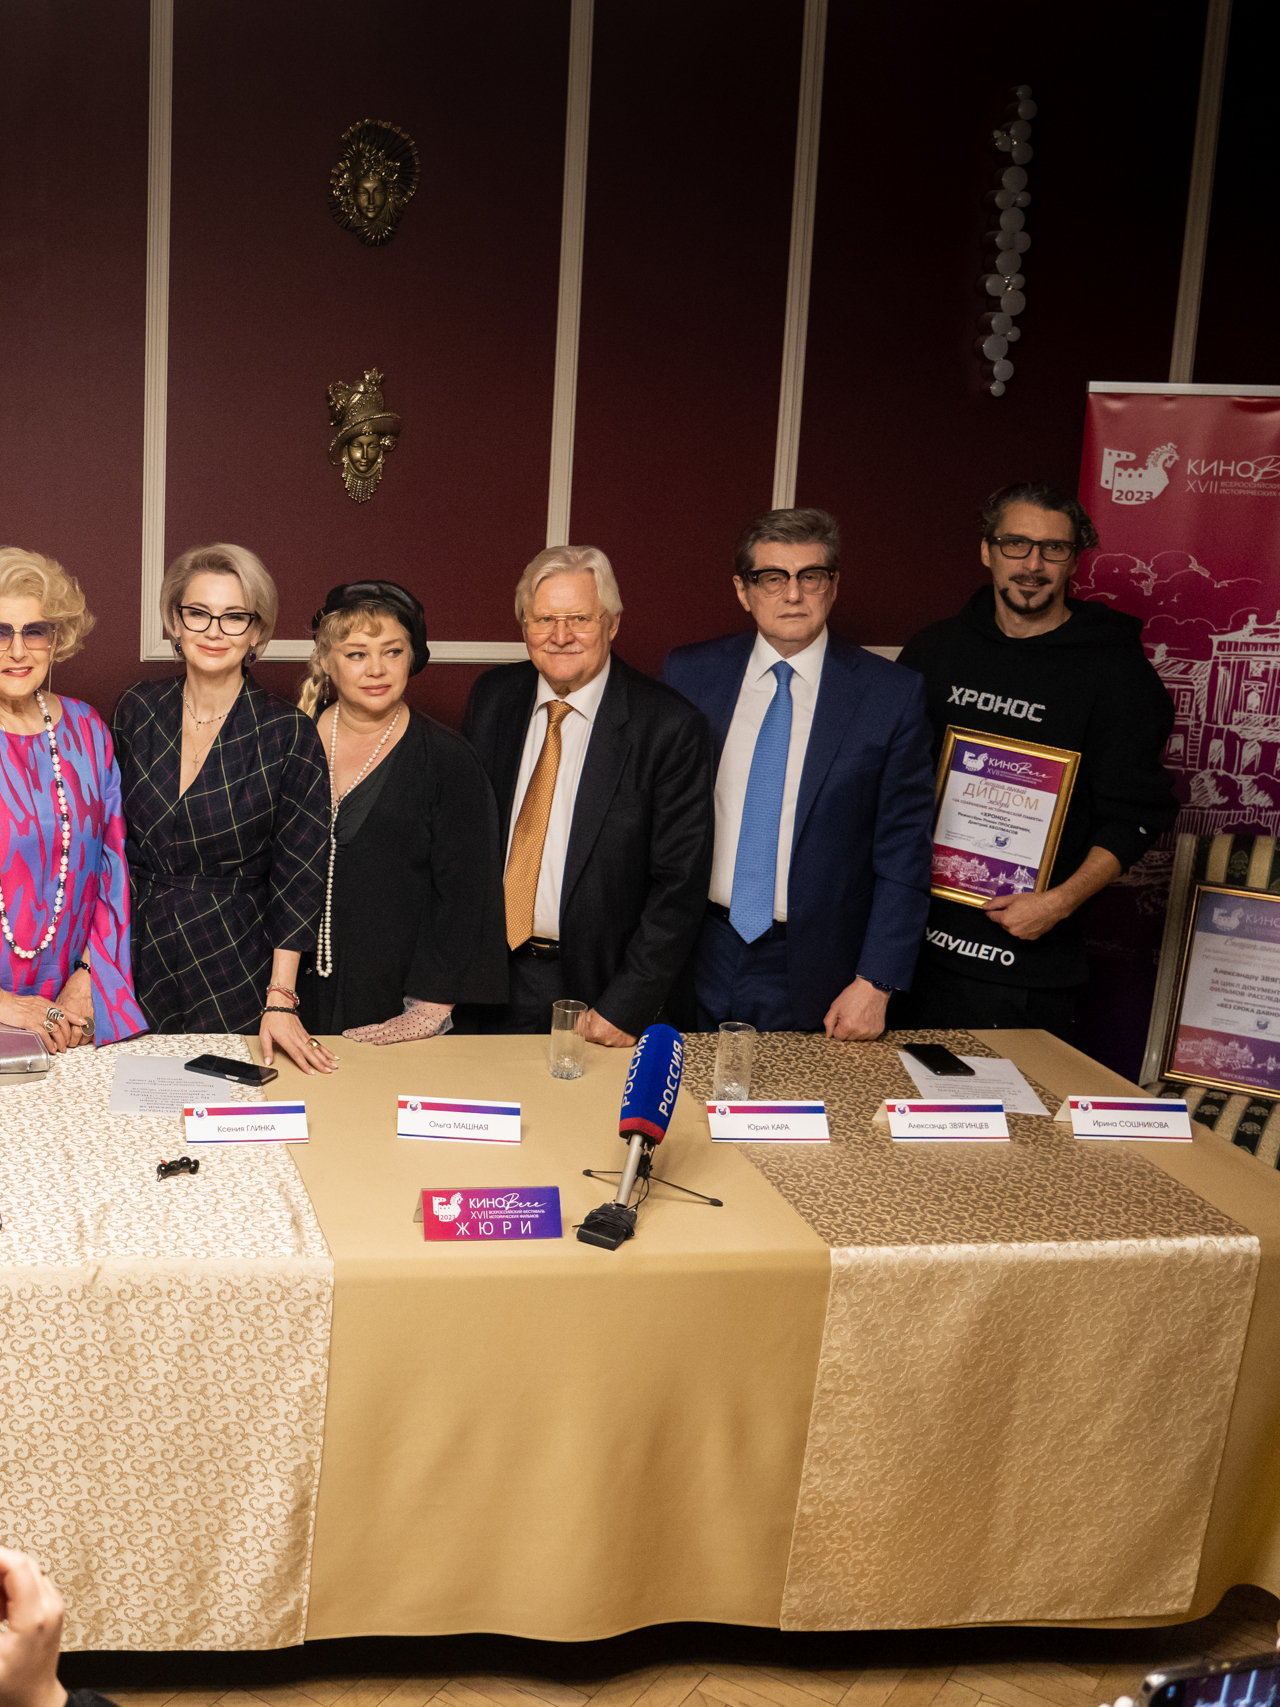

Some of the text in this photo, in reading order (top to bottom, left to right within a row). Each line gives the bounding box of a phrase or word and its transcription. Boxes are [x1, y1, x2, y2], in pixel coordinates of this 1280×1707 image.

[1185, 479, 1218, 494] XVII
[1114, 489, 1154, 502] 2023
[947, 685, 1046, 723] ХРОНОС
[962, 782, 1040, 811] ДИПЛОМ
[925, 926, 1015, 967] УДУЩЕГО
[621, 1033, 649, 1108] РОССИЯ
[658, 1039, 683, 1117] РОССИЯ
[217, 1124, 276, 1133] Ксения ГЛИНКА
[428, 1120, 489, 1131] Ольга МАШНАЯ
[747, 1123, 790, 1132] Юрий КАРА
[908, 1122, 989, 1131] Александр ЗВЯГИНЦЕВ
[1092, 1119, 1170, 1129] Ирина СОШНИКОВА
[470, 1210, 488, 1220] XVII
